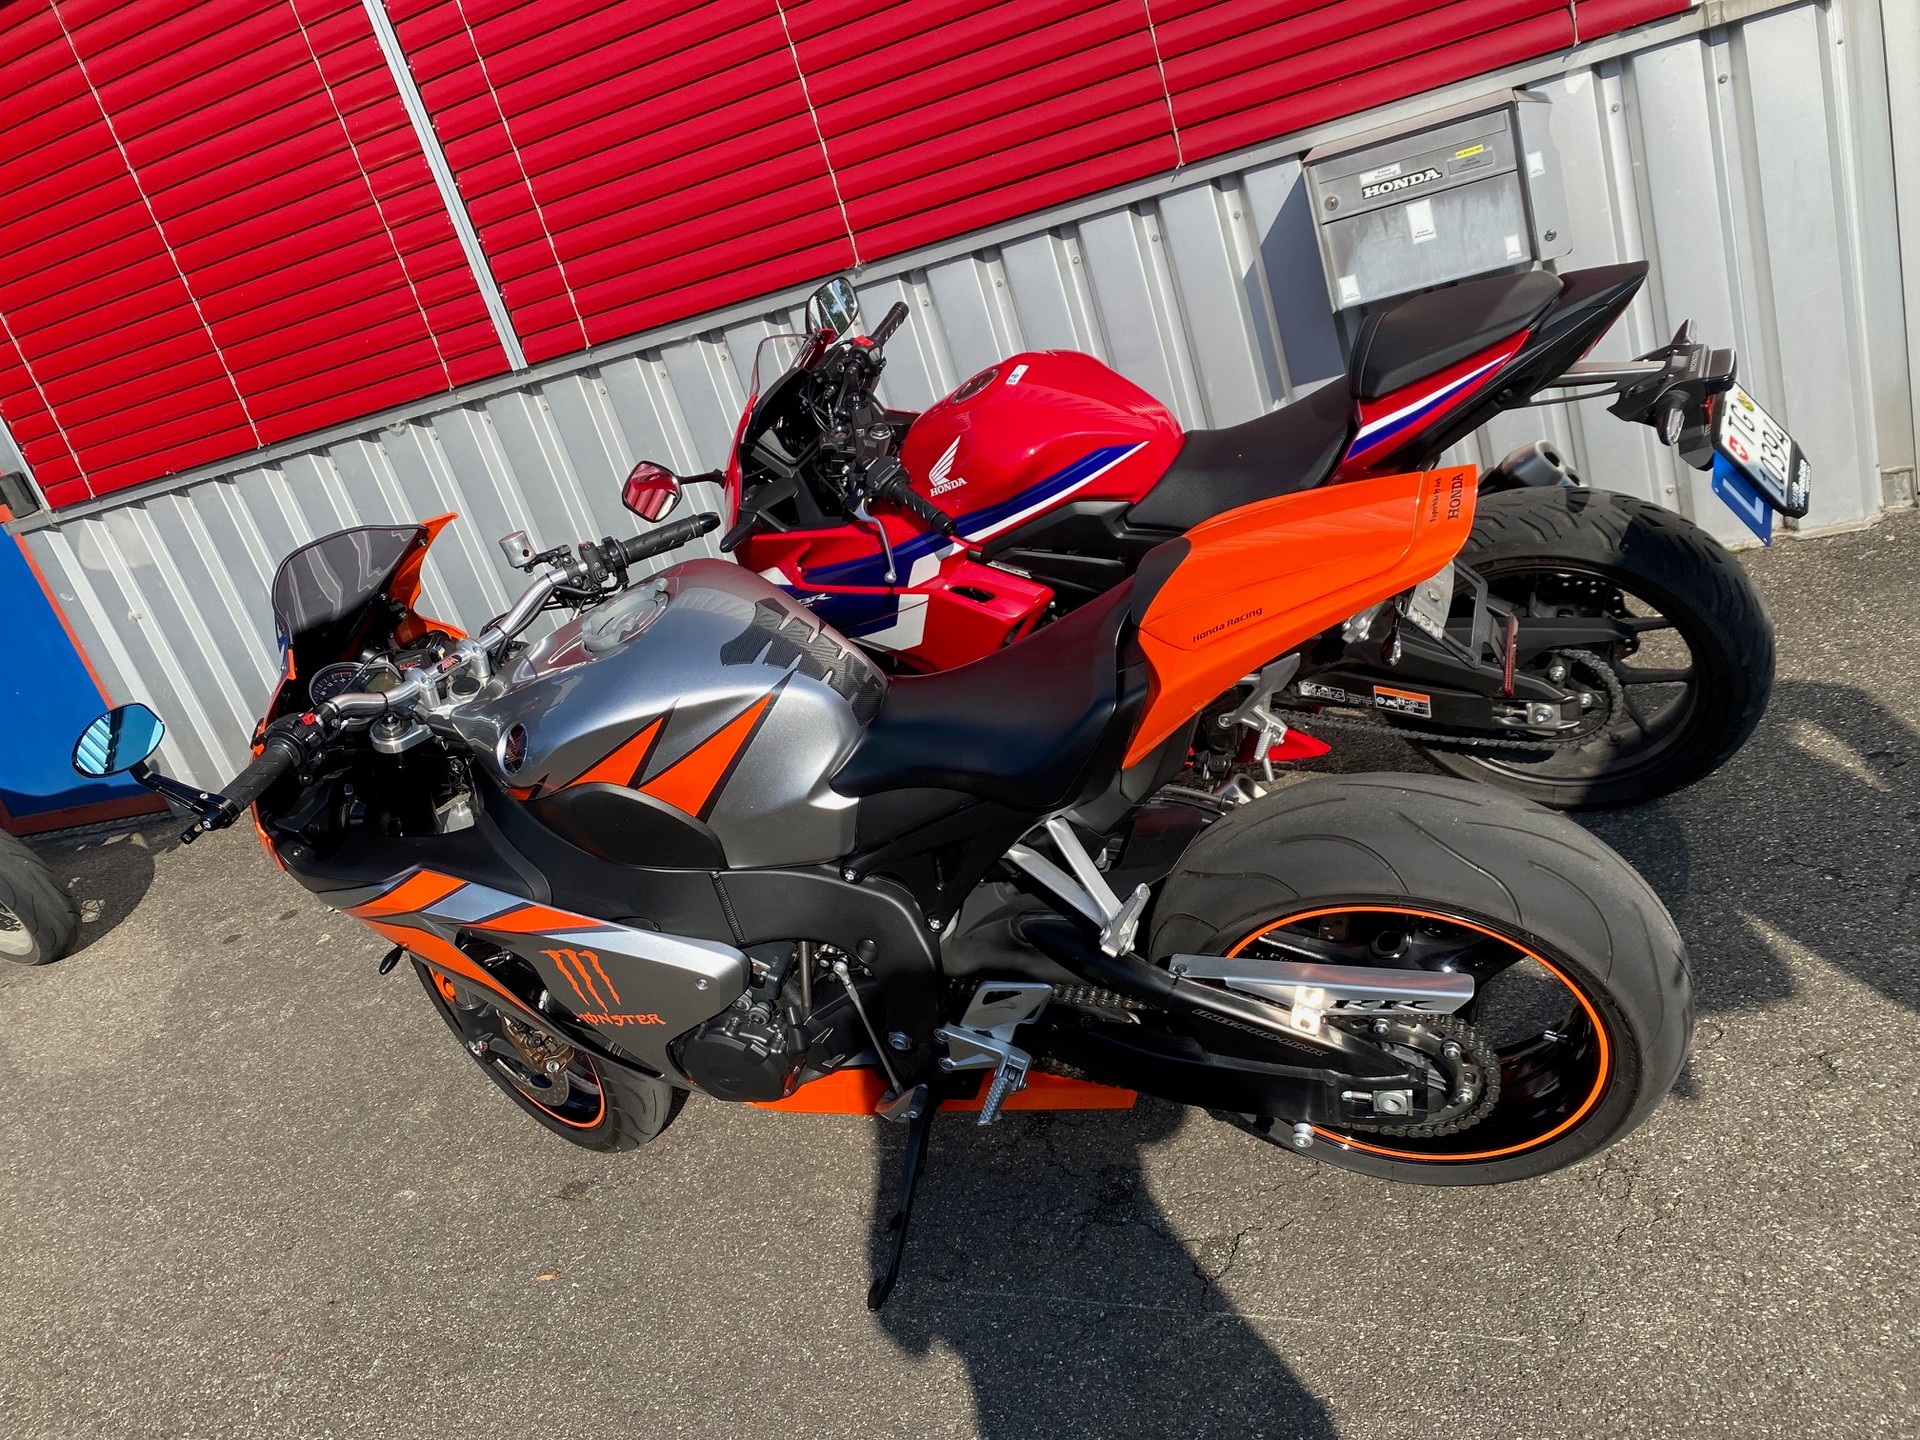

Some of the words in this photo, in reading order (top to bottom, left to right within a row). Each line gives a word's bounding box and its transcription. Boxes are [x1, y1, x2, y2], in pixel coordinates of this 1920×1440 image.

[1363, 168, 1442, 199] HONDA
[1728, 403, 1755, 446] TG
[1758, 418, 1789, 498] 10394
[930, 477, 968, 498] HONDA
[1447, 473, 1464, 521] HONDA
[1722, 478, 1764, 524] L
[1192, 623, 1226, 643] Honda
[1226, 607, 1263, 627] Racing
